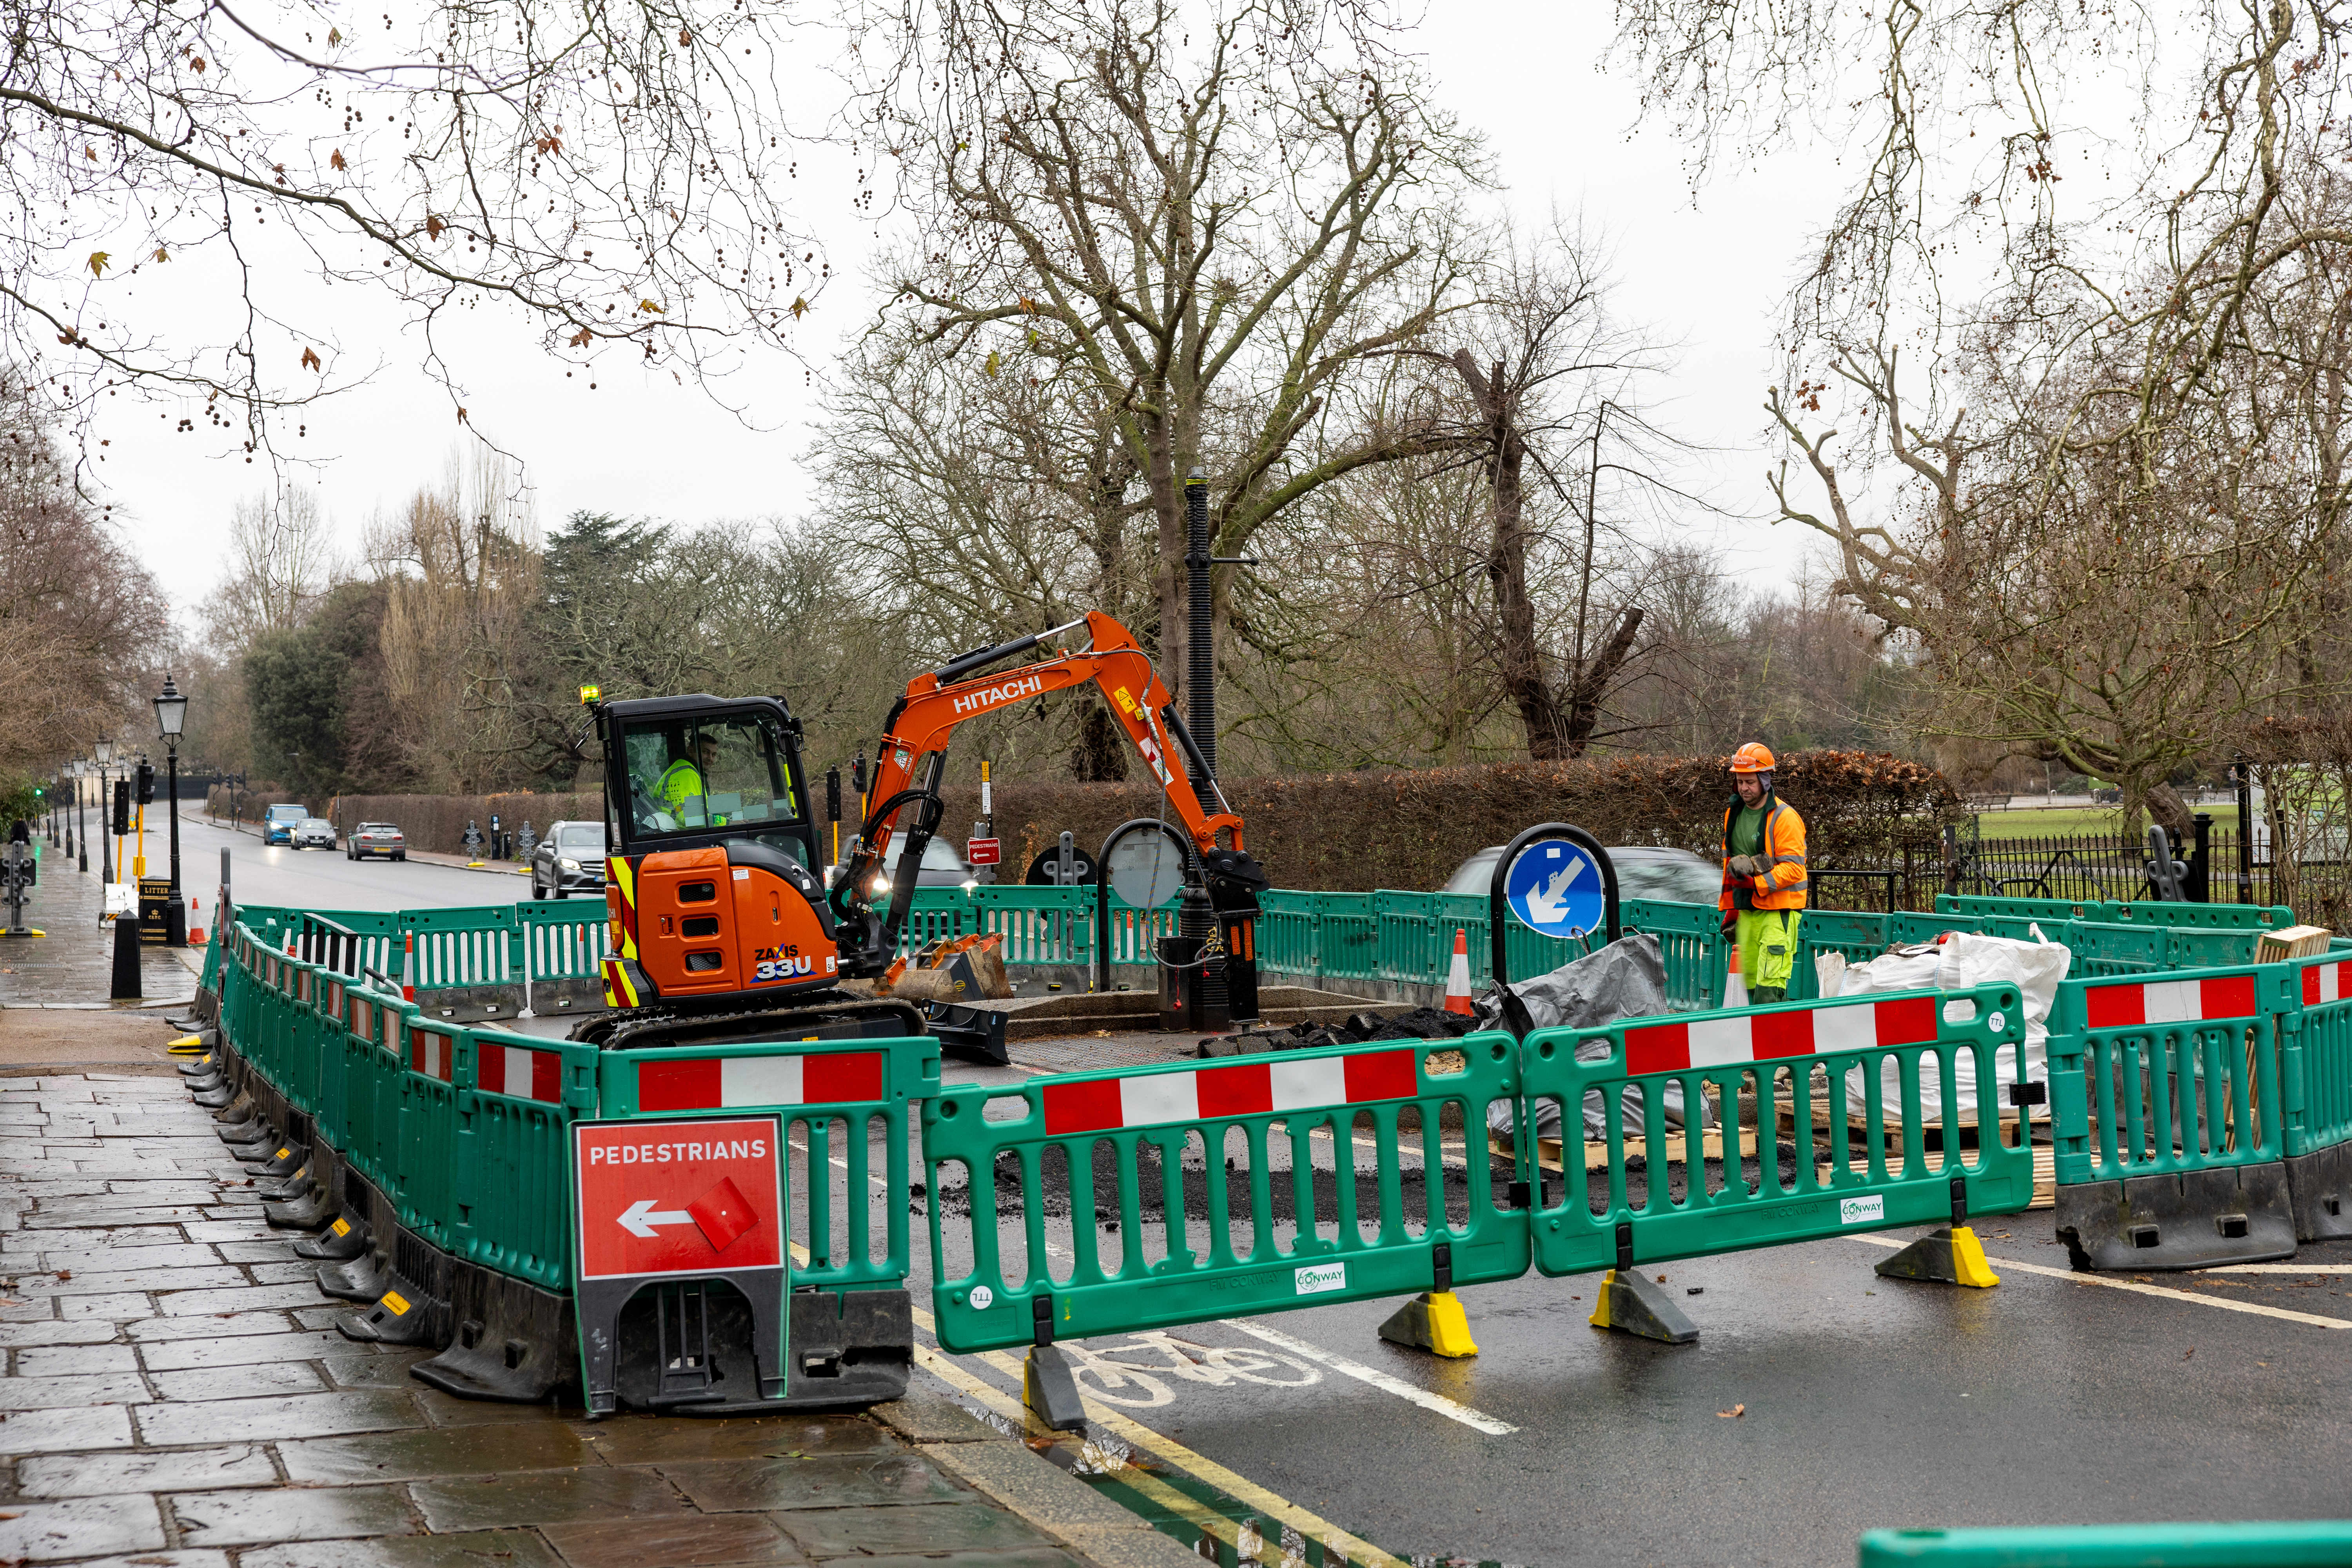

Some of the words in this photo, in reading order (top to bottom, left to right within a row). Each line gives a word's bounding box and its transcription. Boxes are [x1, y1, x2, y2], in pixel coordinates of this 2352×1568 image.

[953, 675, 1042, 713] HITACHI
[755, 943, 798, 962] ZAXIS
[756, 955, 811, 982] 33U
[1991, 1017, 2004, 1027] TTL
[590, 1139, 766, 1165] PEDESTRIANS
[1761, 1209, 1775, 1220] FM
[1778, 1202, 1821, 1218] CONWAY
[1842, 1202, 1881, 1214] CONWAY
[1210, 1278, 1227, 1290] FM
[1230, 1272, 1281, 1288] CONWAY
[1297, 1270, 1343, 1286] CONWAY
[972, 1293, 990, 1302] TTL
